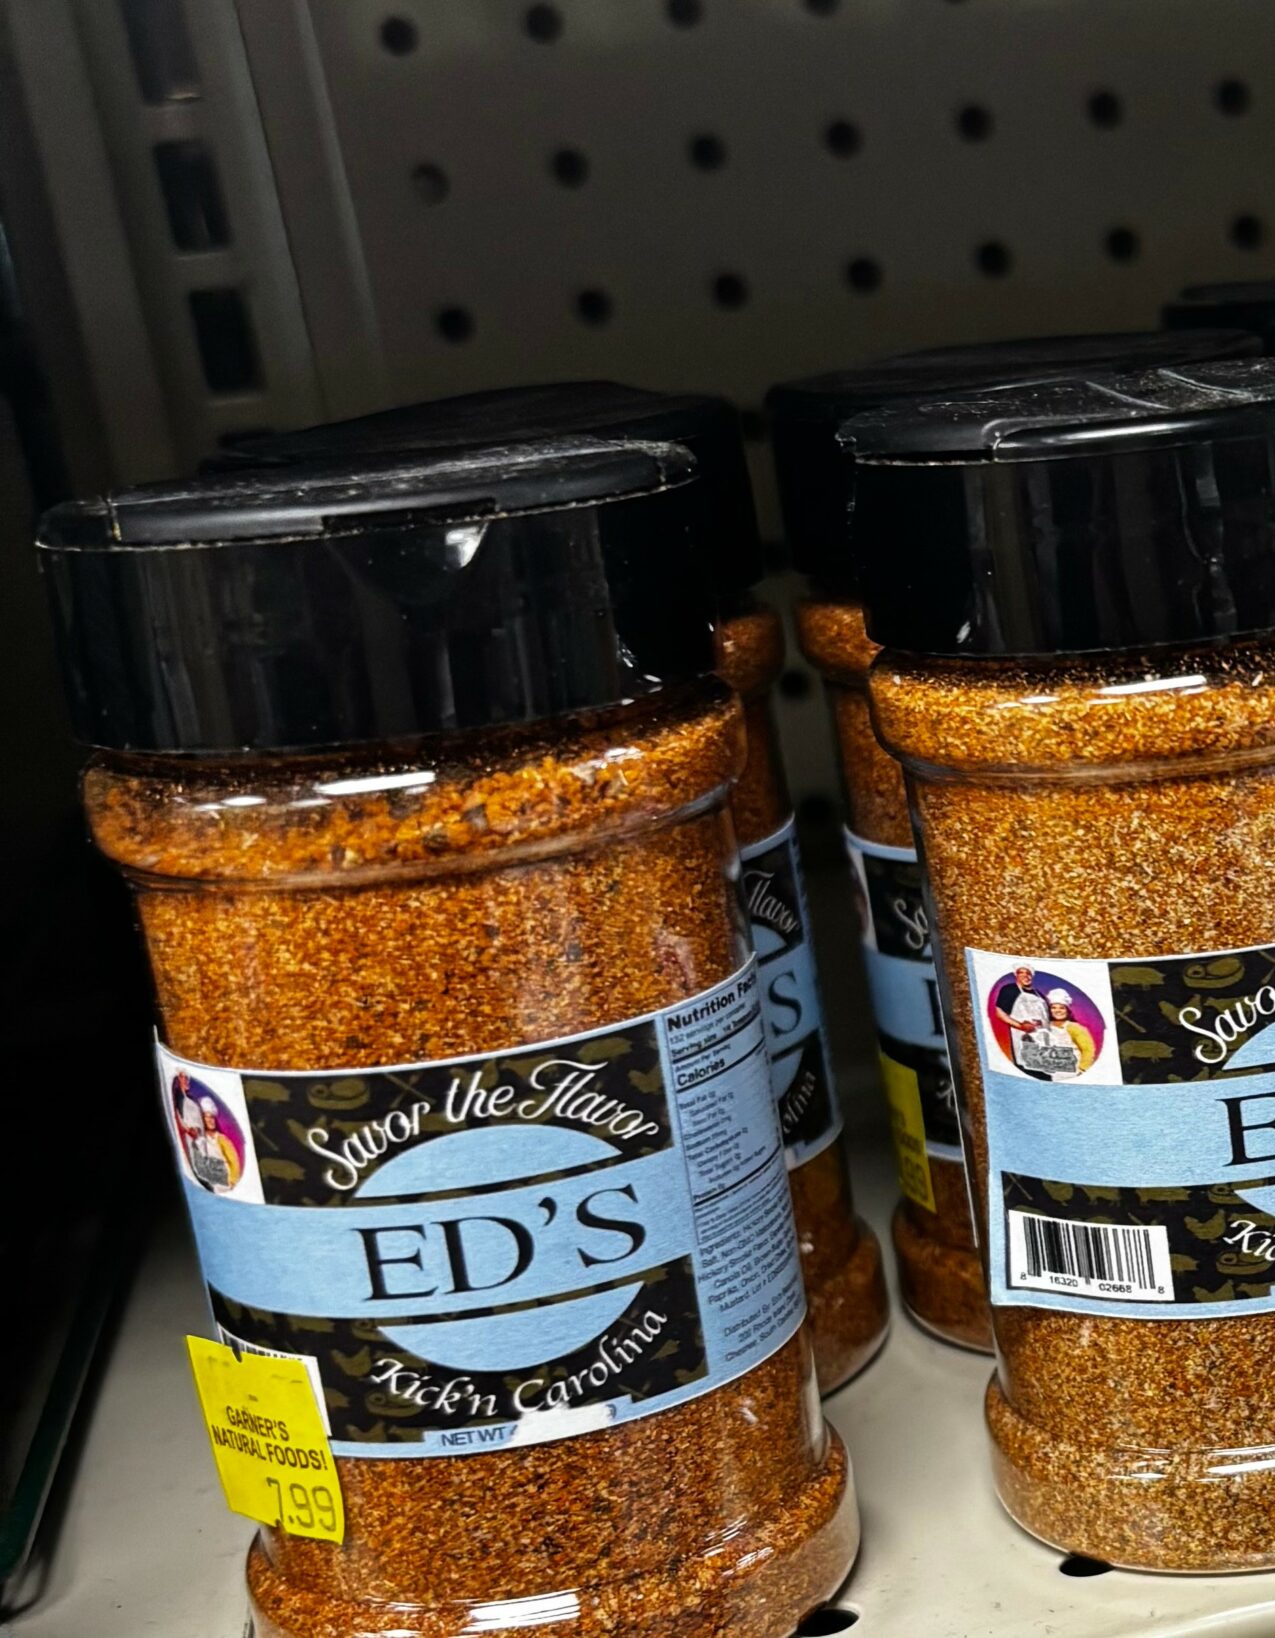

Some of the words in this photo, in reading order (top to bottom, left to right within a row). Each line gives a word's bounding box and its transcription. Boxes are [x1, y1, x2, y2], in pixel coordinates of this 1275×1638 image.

[667, 992, 736, 1032] Nutrition
[677, 1058, 726, 1087] Calories
[308, 1100, 430, 1191] Savor
[446, 1071, 514, 1123] the
[518, 1060, 659, 1140] Flavor
[783, 1071, 816, 1134] olina
[351, 1184, 647, 1301] ED'S
[1020, 1272, 1027, 1281] 8
[1049, 1276, 1079, 1288] 16320
[1157, 1285, 1165, 1294] 8
[371, 1358, 498, 1416] Kick'n
[513, 1310, 668, 1413] Carolina
[226, 1405, 290, 1442] GARNER'S
[441, 1427, 475, 1448] NET
[478, 1425, 506, 1442] WT
[211, 1425, 267, 1461] NATURAL
[268, 1444, 329, 1471] FOODS!
[266, 1477, 337, 1532] 7.99
